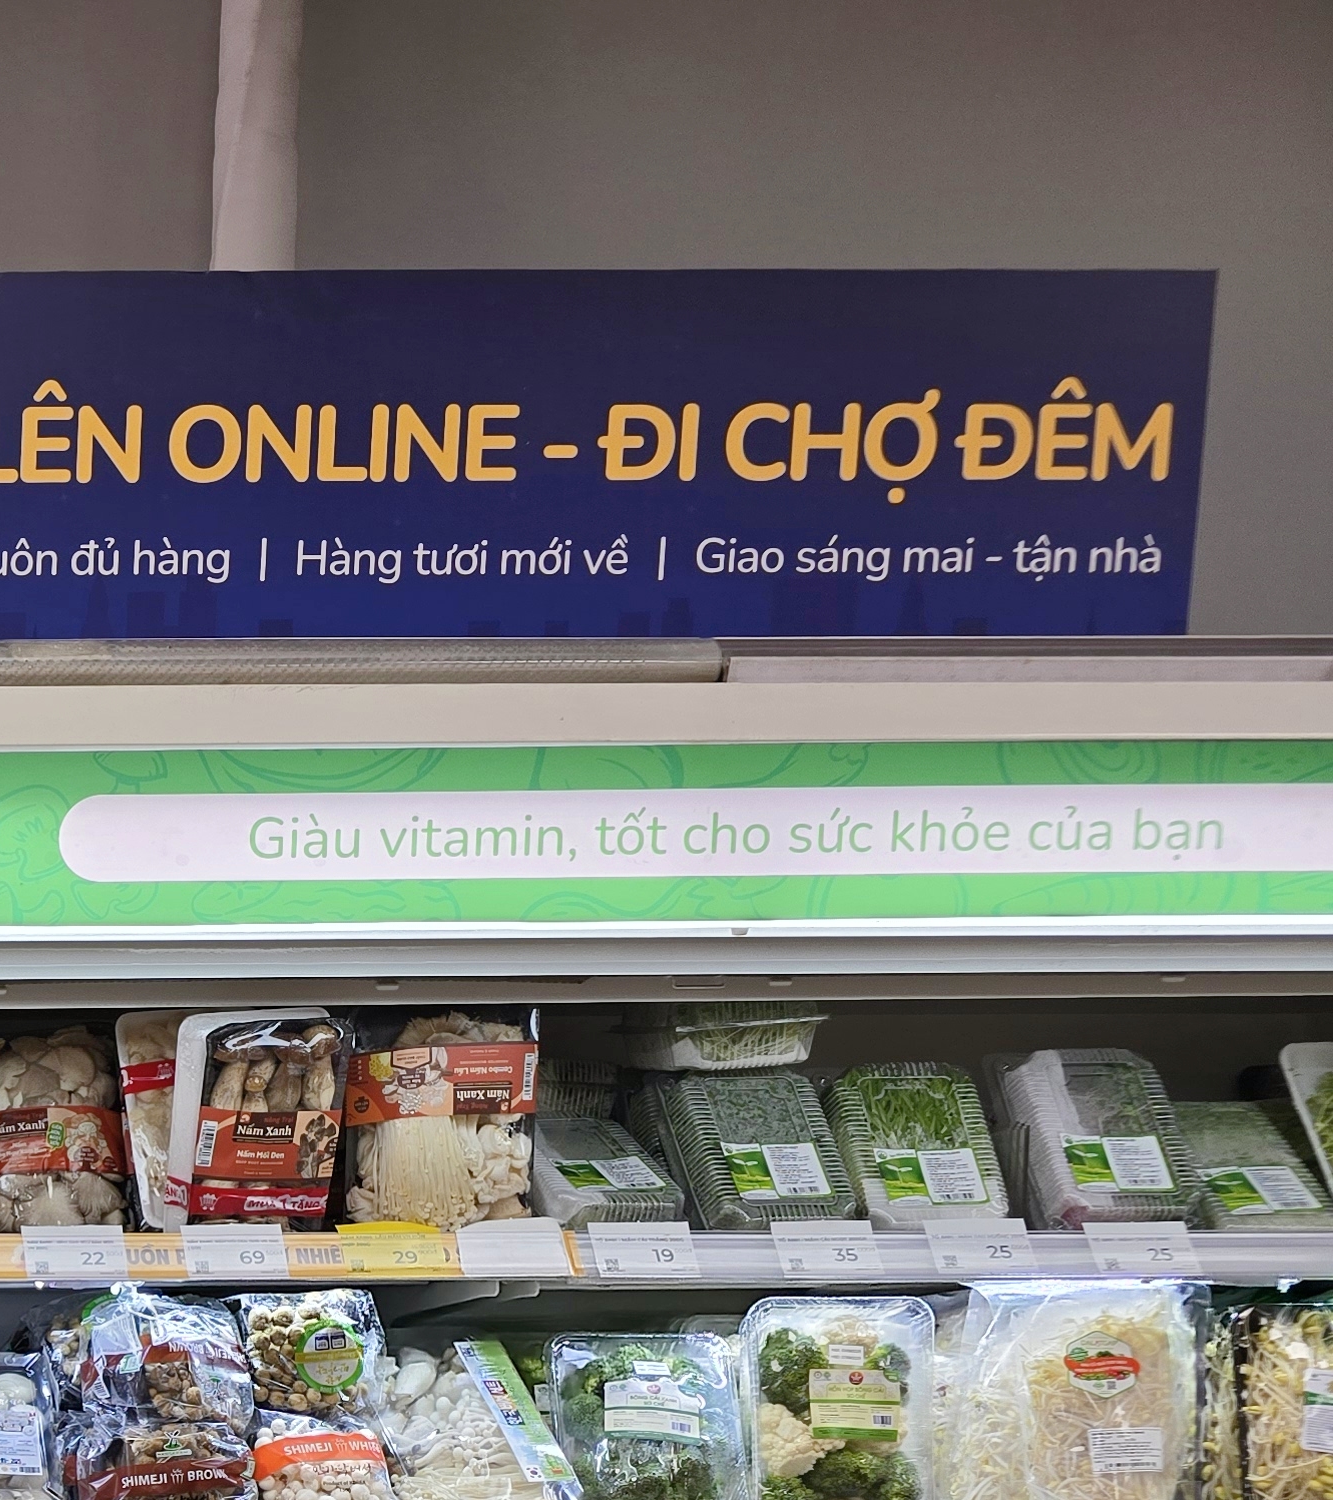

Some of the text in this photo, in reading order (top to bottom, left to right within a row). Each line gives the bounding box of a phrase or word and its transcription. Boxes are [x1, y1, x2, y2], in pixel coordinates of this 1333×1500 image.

[169, 404, 520, 483] ONLINE
[597, 403, 700, 481] ĐI
[726, 389, 940, 503] CHỢ
[954, 377, 1173, 481] ĐÊM
[71, 537, 119, 575] đủ
[133, 537, 230, 583] hàng
[297, 537, 401, 583] Hàng
[413, 540, 487, 575] tươi
[501, 537, 572, 574] mới
[583, 534, 628, 574] về
[697, 537, 784, 573] Giao
[796, 535, 890, 581] sáng
[902, 540, 975, 574] mai
[1013, 535, 1077, 581] tận
[1089, 534, 1161, 573] nhà
[250, 806, 1224, 865] Giàu vitamin, tốt cho sức khỏe của bạn
[236, 1123, 293, 1137] Nấm Xanh
[240, 1251, 264, 1264] 69
[832, 1248, 858, 1261] 35
[284, 1443, 332, 1457] SHIMEJI
[121, 1474, 168, 1490] SHIMEJI
